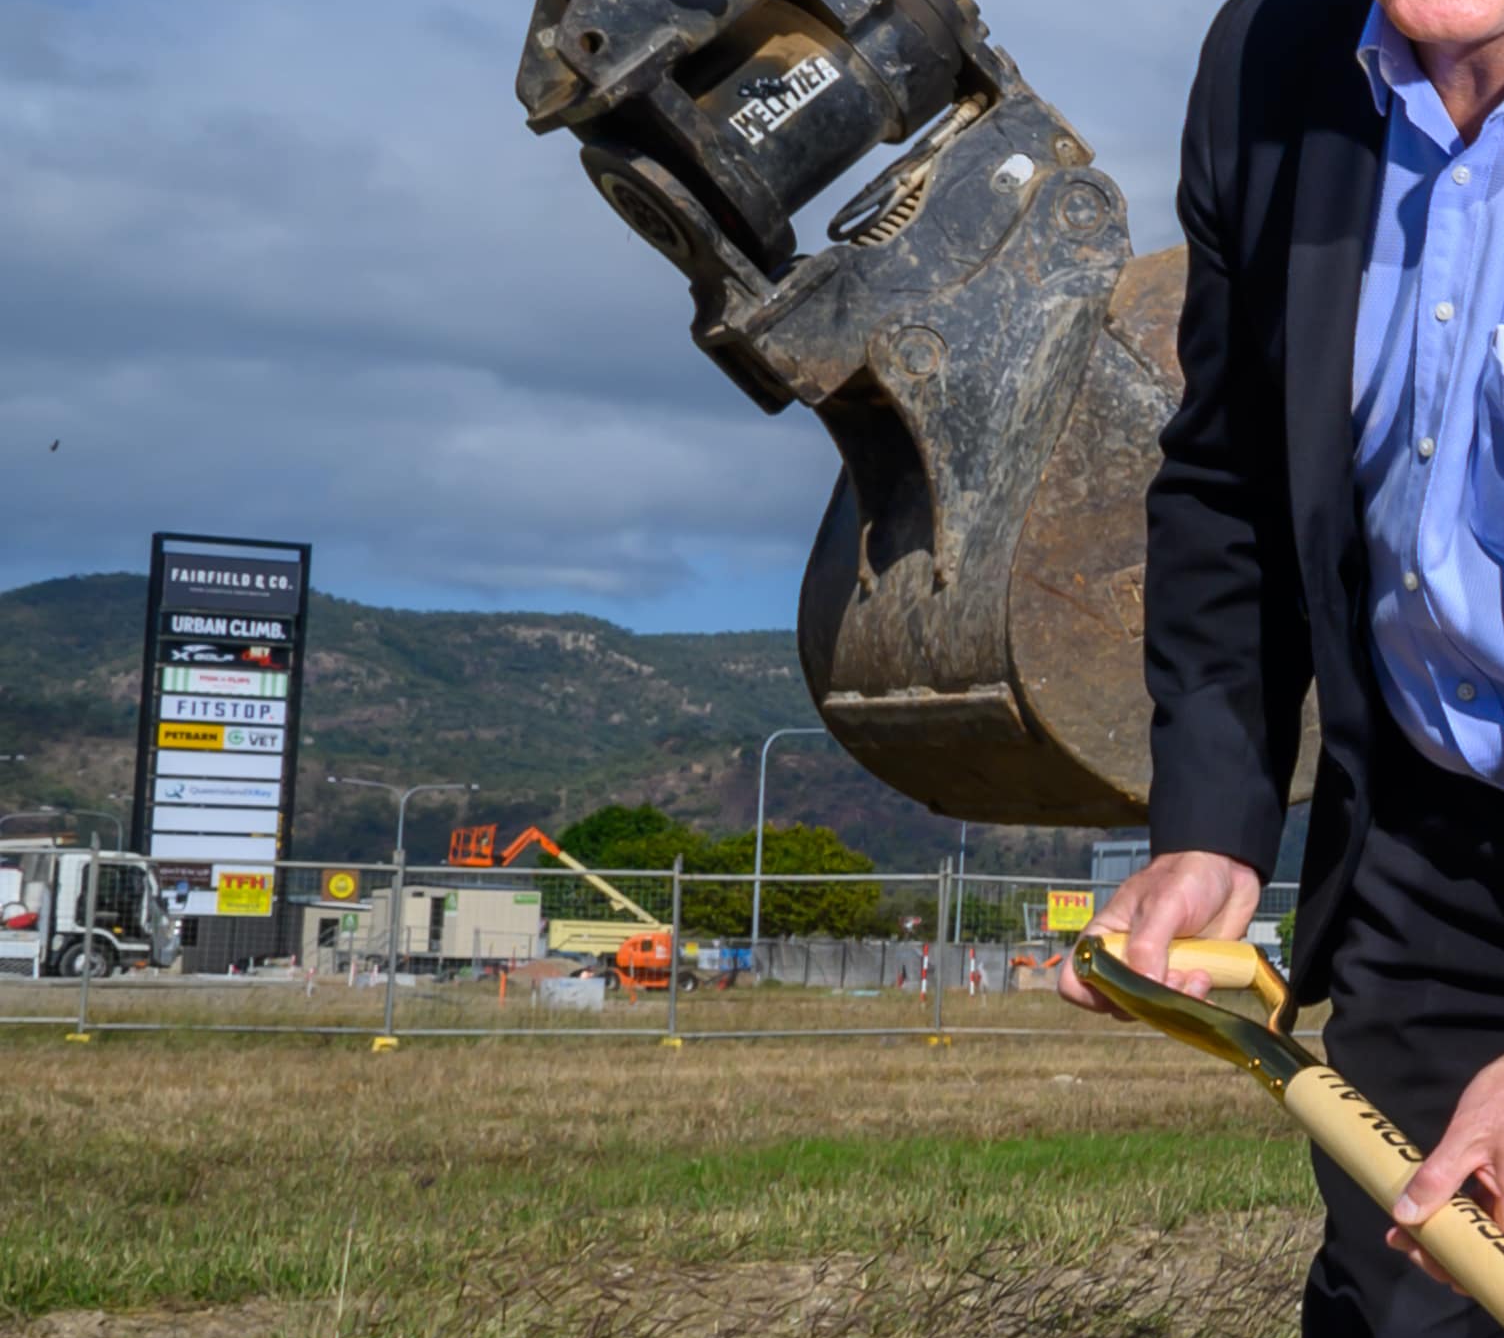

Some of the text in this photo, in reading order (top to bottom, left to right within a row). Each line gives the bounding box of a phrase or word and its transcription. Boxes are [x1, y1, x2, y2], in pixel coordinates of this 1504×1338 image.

[171, 568, 250, 587] FAIRFIELD
[268, 575, 293, 590] CO.
[171, 615, 286, 640] URBAN CLIMB.
[164, 730, 218, 742] PETBARN
[249, 734, 278, 747] VET
[224, 874, 265, 890] TFH
